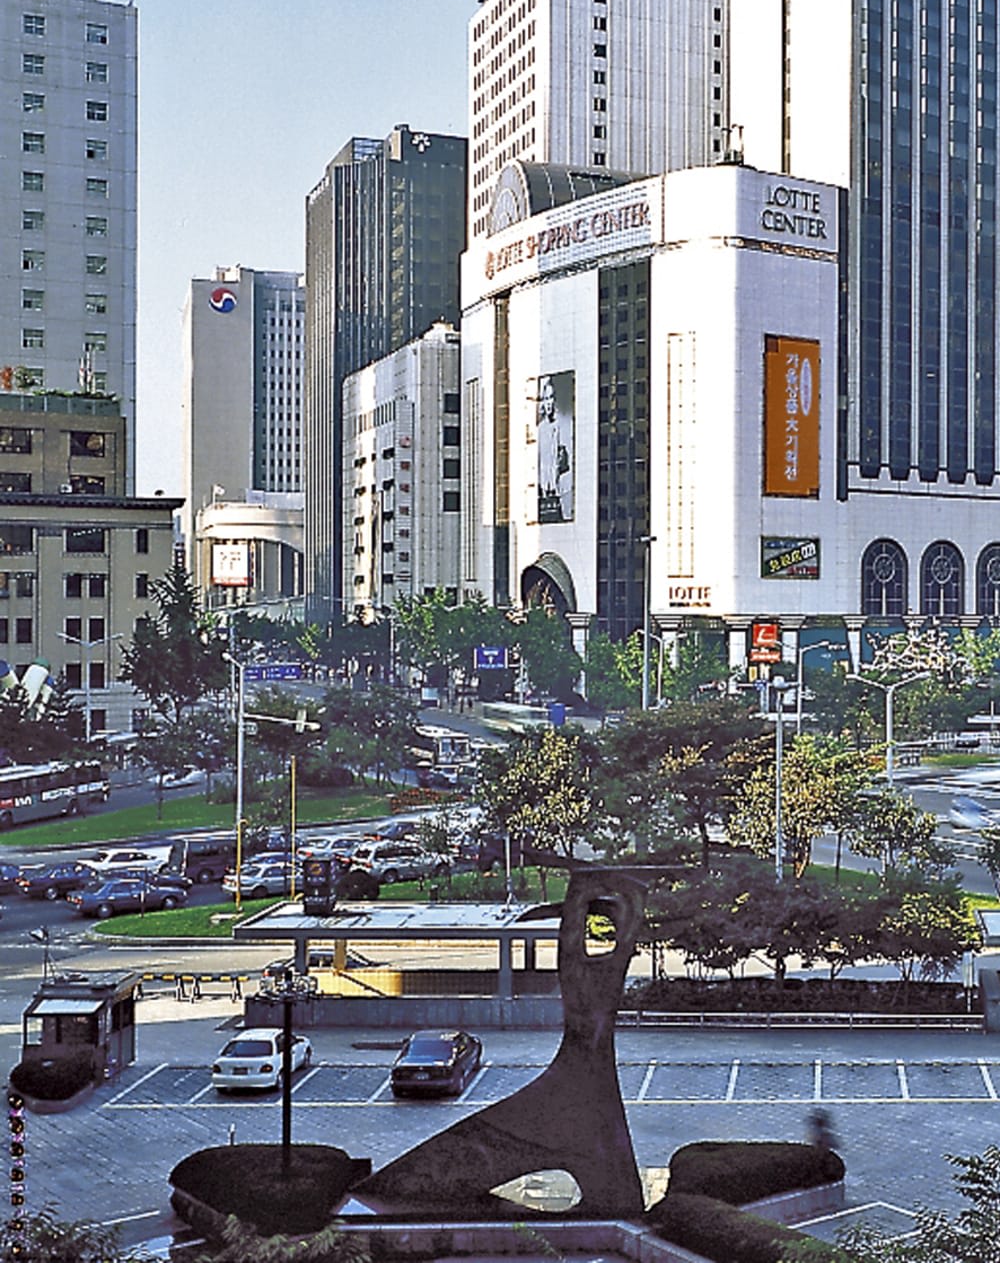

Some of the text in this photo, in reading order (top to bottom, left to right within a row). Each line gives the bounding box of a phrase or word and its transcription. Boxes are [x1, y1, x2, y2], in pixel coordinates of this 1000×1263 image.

[764, 186, 820, 213] LOTTE
[496, 200, 652, 273] LOTTE SHOPPING CENTER
[762, 209, 827, 239] CENTER
